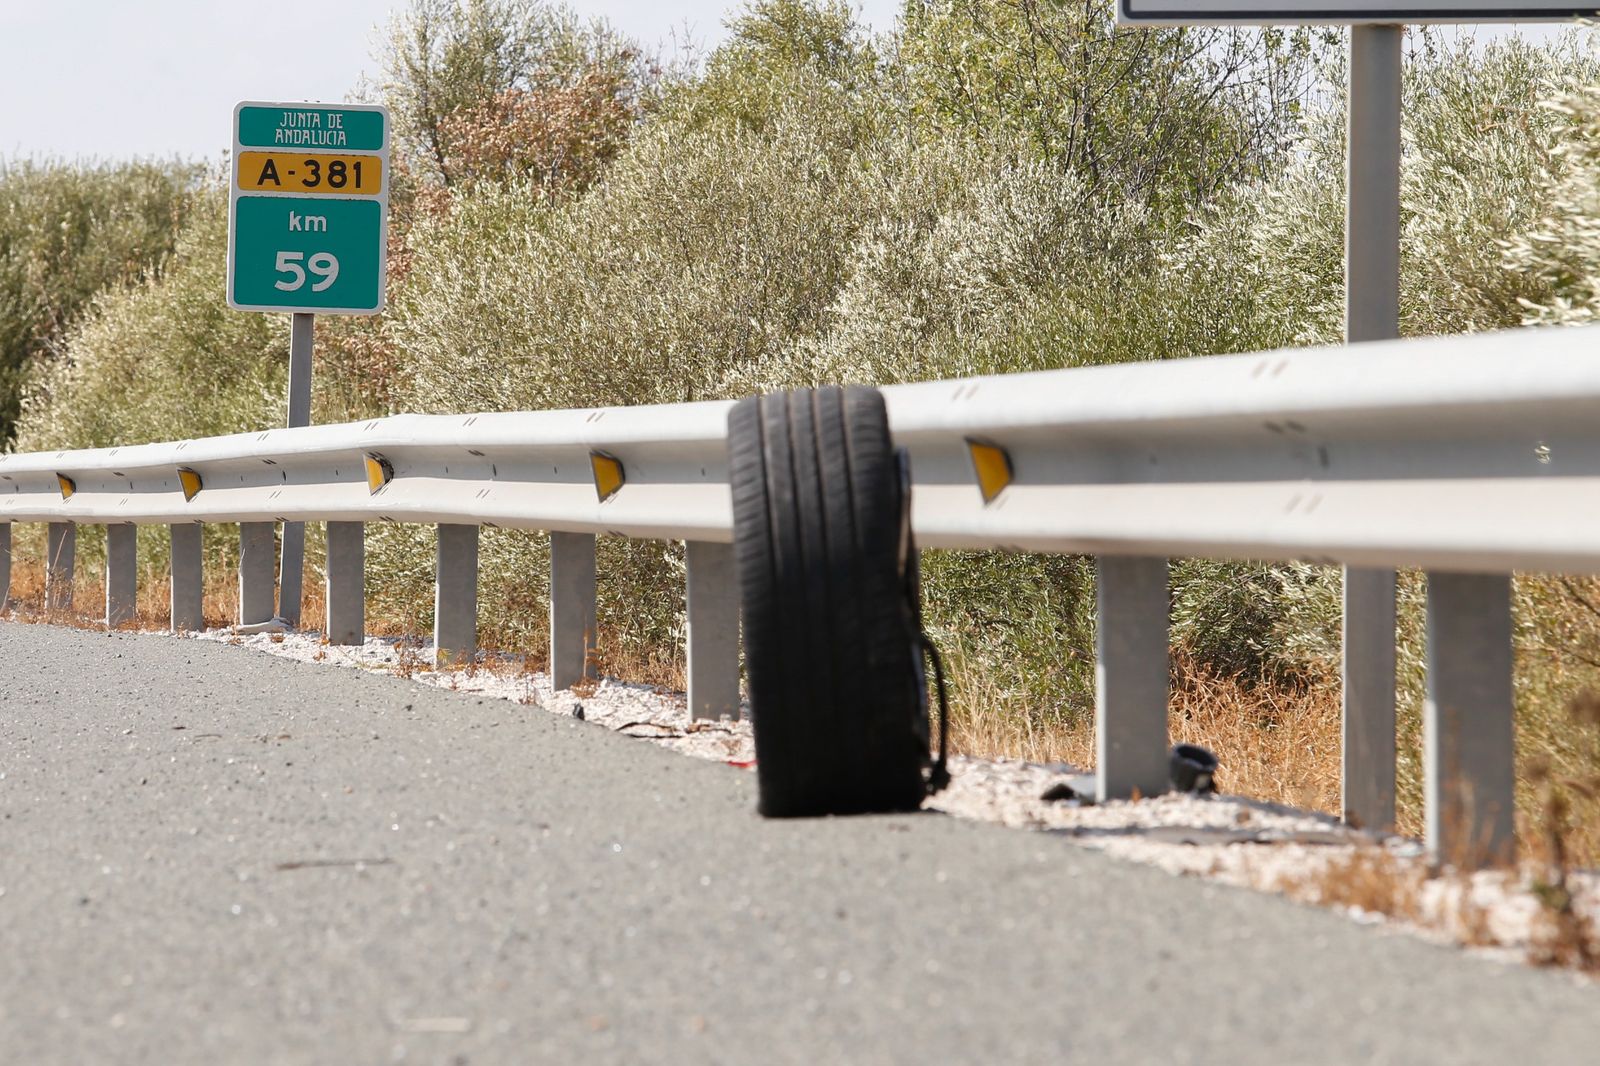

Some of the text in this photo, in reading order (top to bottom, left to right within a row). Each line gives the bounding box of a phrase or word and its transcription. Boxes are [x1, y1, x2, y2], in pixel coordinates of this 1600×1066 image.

[280, 112, 344, 129] JUNTA DE
[275, 128, 347, 146] ANDALUCIA
[257, 158, 362, 189] A-381
[289, 210, 328, 232] km
[274, 250, 340, 292] 59
